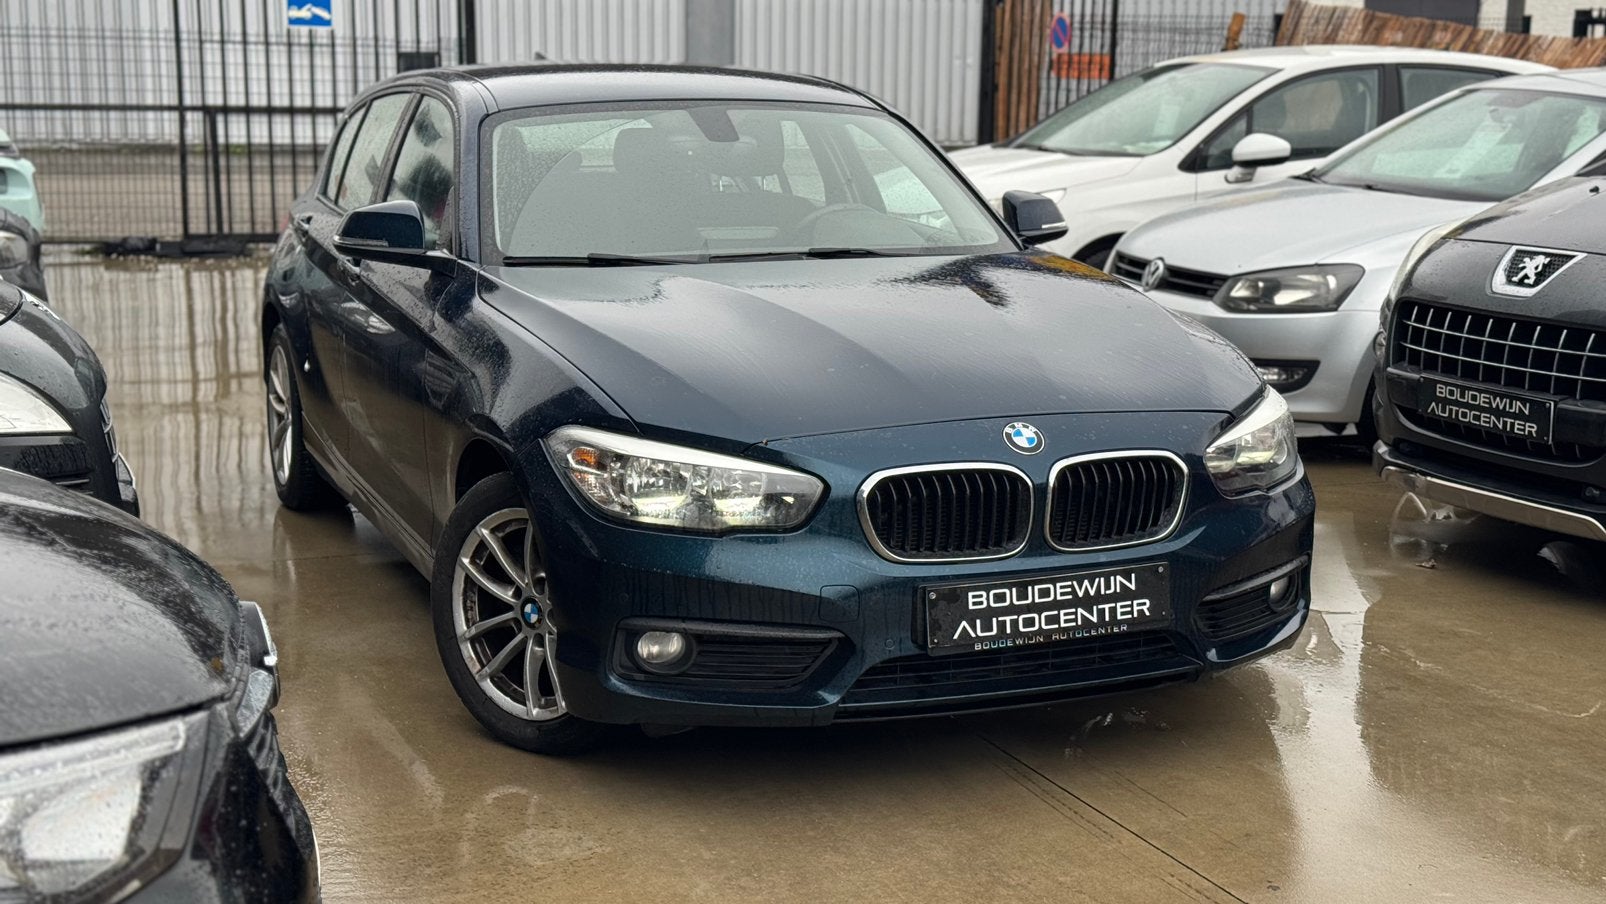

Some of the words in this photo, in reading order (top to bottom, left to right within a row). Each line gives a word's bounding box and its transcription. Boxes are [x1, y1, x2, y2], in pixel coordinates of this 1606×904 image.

[1436, 383, 1529, 415] BOUDEWIJN
[1427, 401, 1537, 437] AUTOCENTER
[967, 573, 1136, 610] BOUDEWIJN
[953, 599, 1151, 640] AUTOCENTER
[974, 635, 1044, 651] BOUDEWIJN
[1052, 624, 1129, 640] AUTOCENTER
